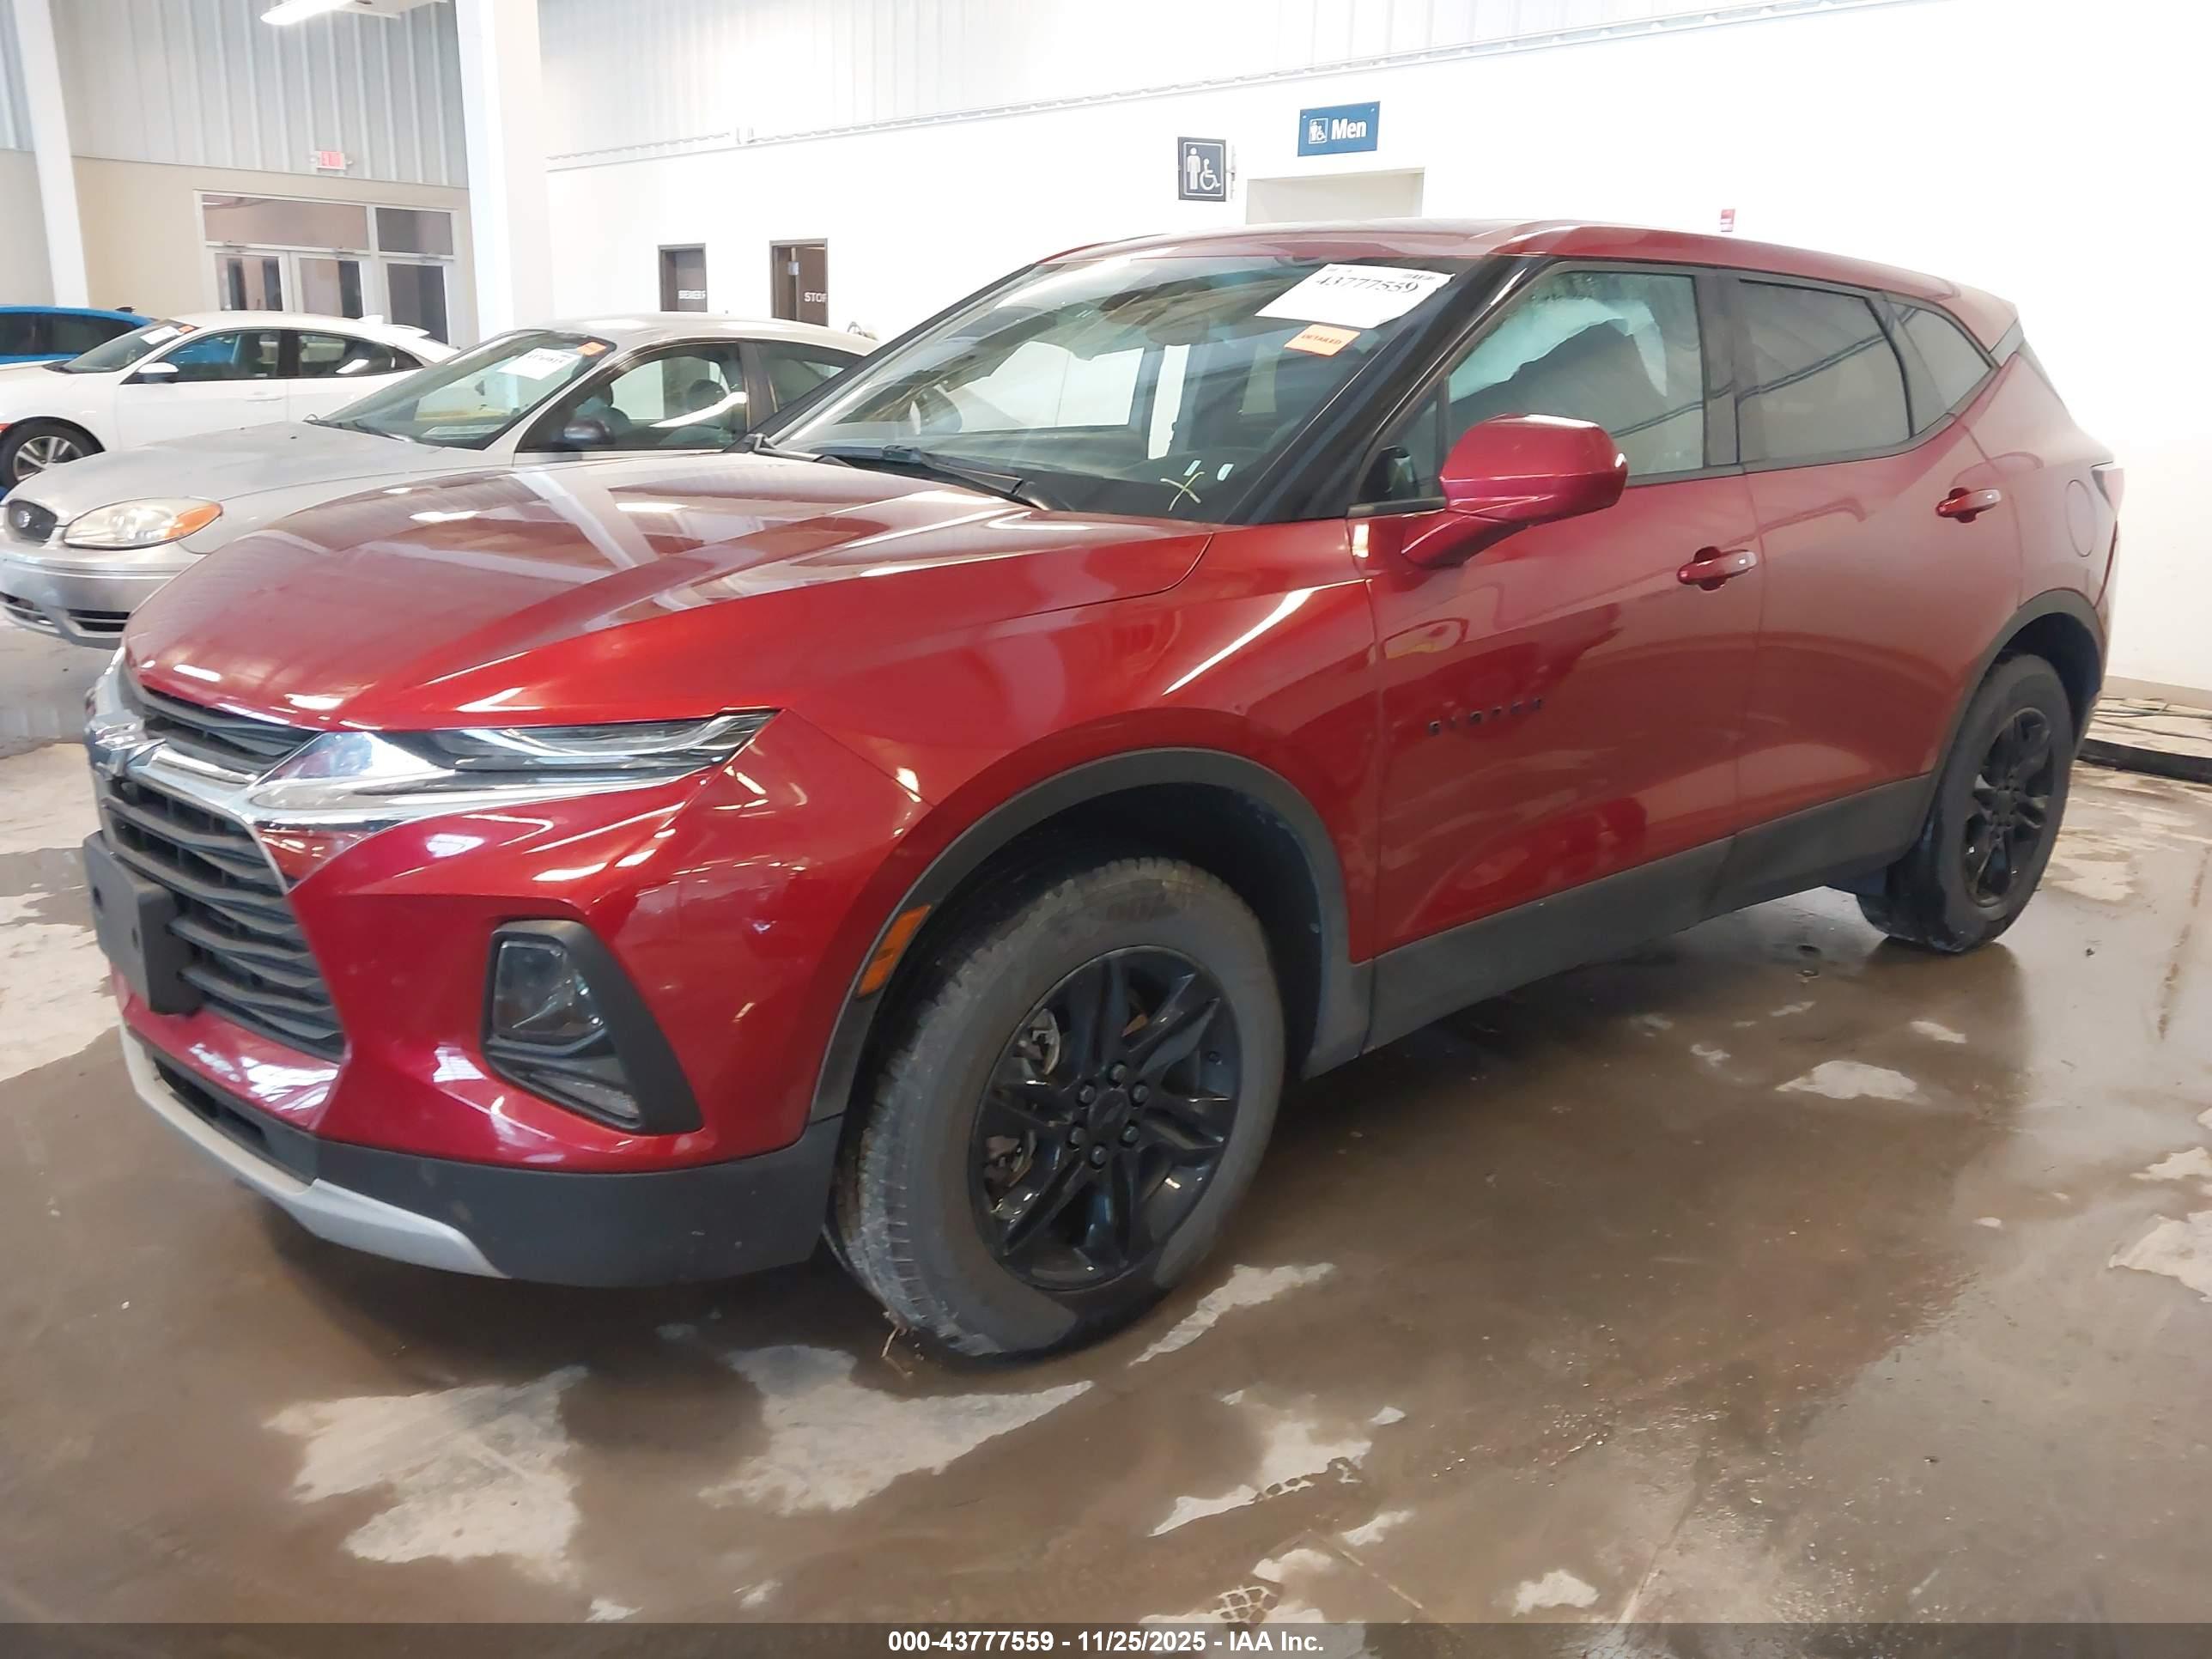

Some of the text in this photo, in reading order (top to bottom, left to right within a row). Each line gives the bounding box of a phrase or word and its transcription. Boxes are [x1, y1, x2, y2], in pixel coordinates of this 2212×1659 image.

[1331, 118, 1367, 140] Men
[1316, 276, 1419, 294] 43777559
[1300, 333, 1342, 345] DETAILED
